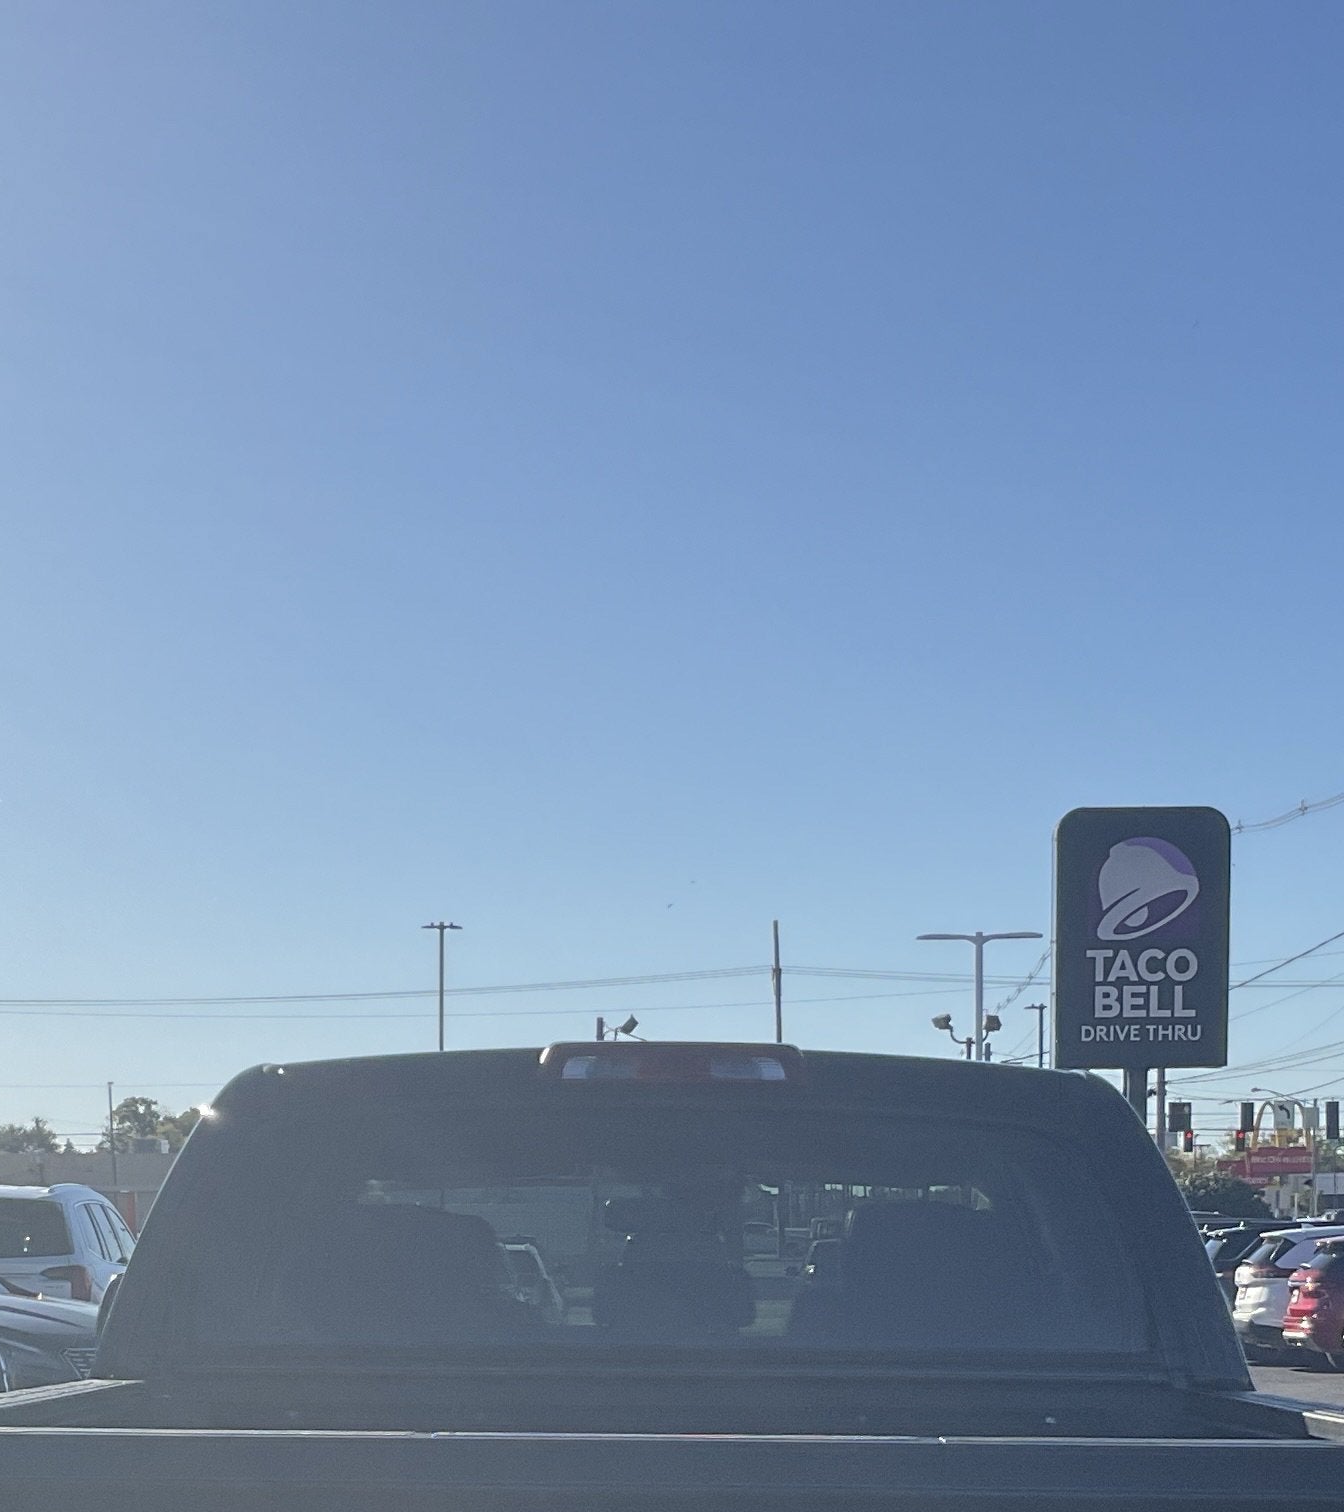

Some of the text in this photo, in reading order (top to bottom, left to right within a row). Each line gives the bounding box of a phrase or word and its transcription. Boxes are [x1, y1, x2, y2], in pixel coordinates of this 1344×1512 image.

[1086, 948, 1198, 982] TACO
[1094, 985, 1197, 1018] BELL
[1081, 1024, 1202, 1042] DRIVE THRU
